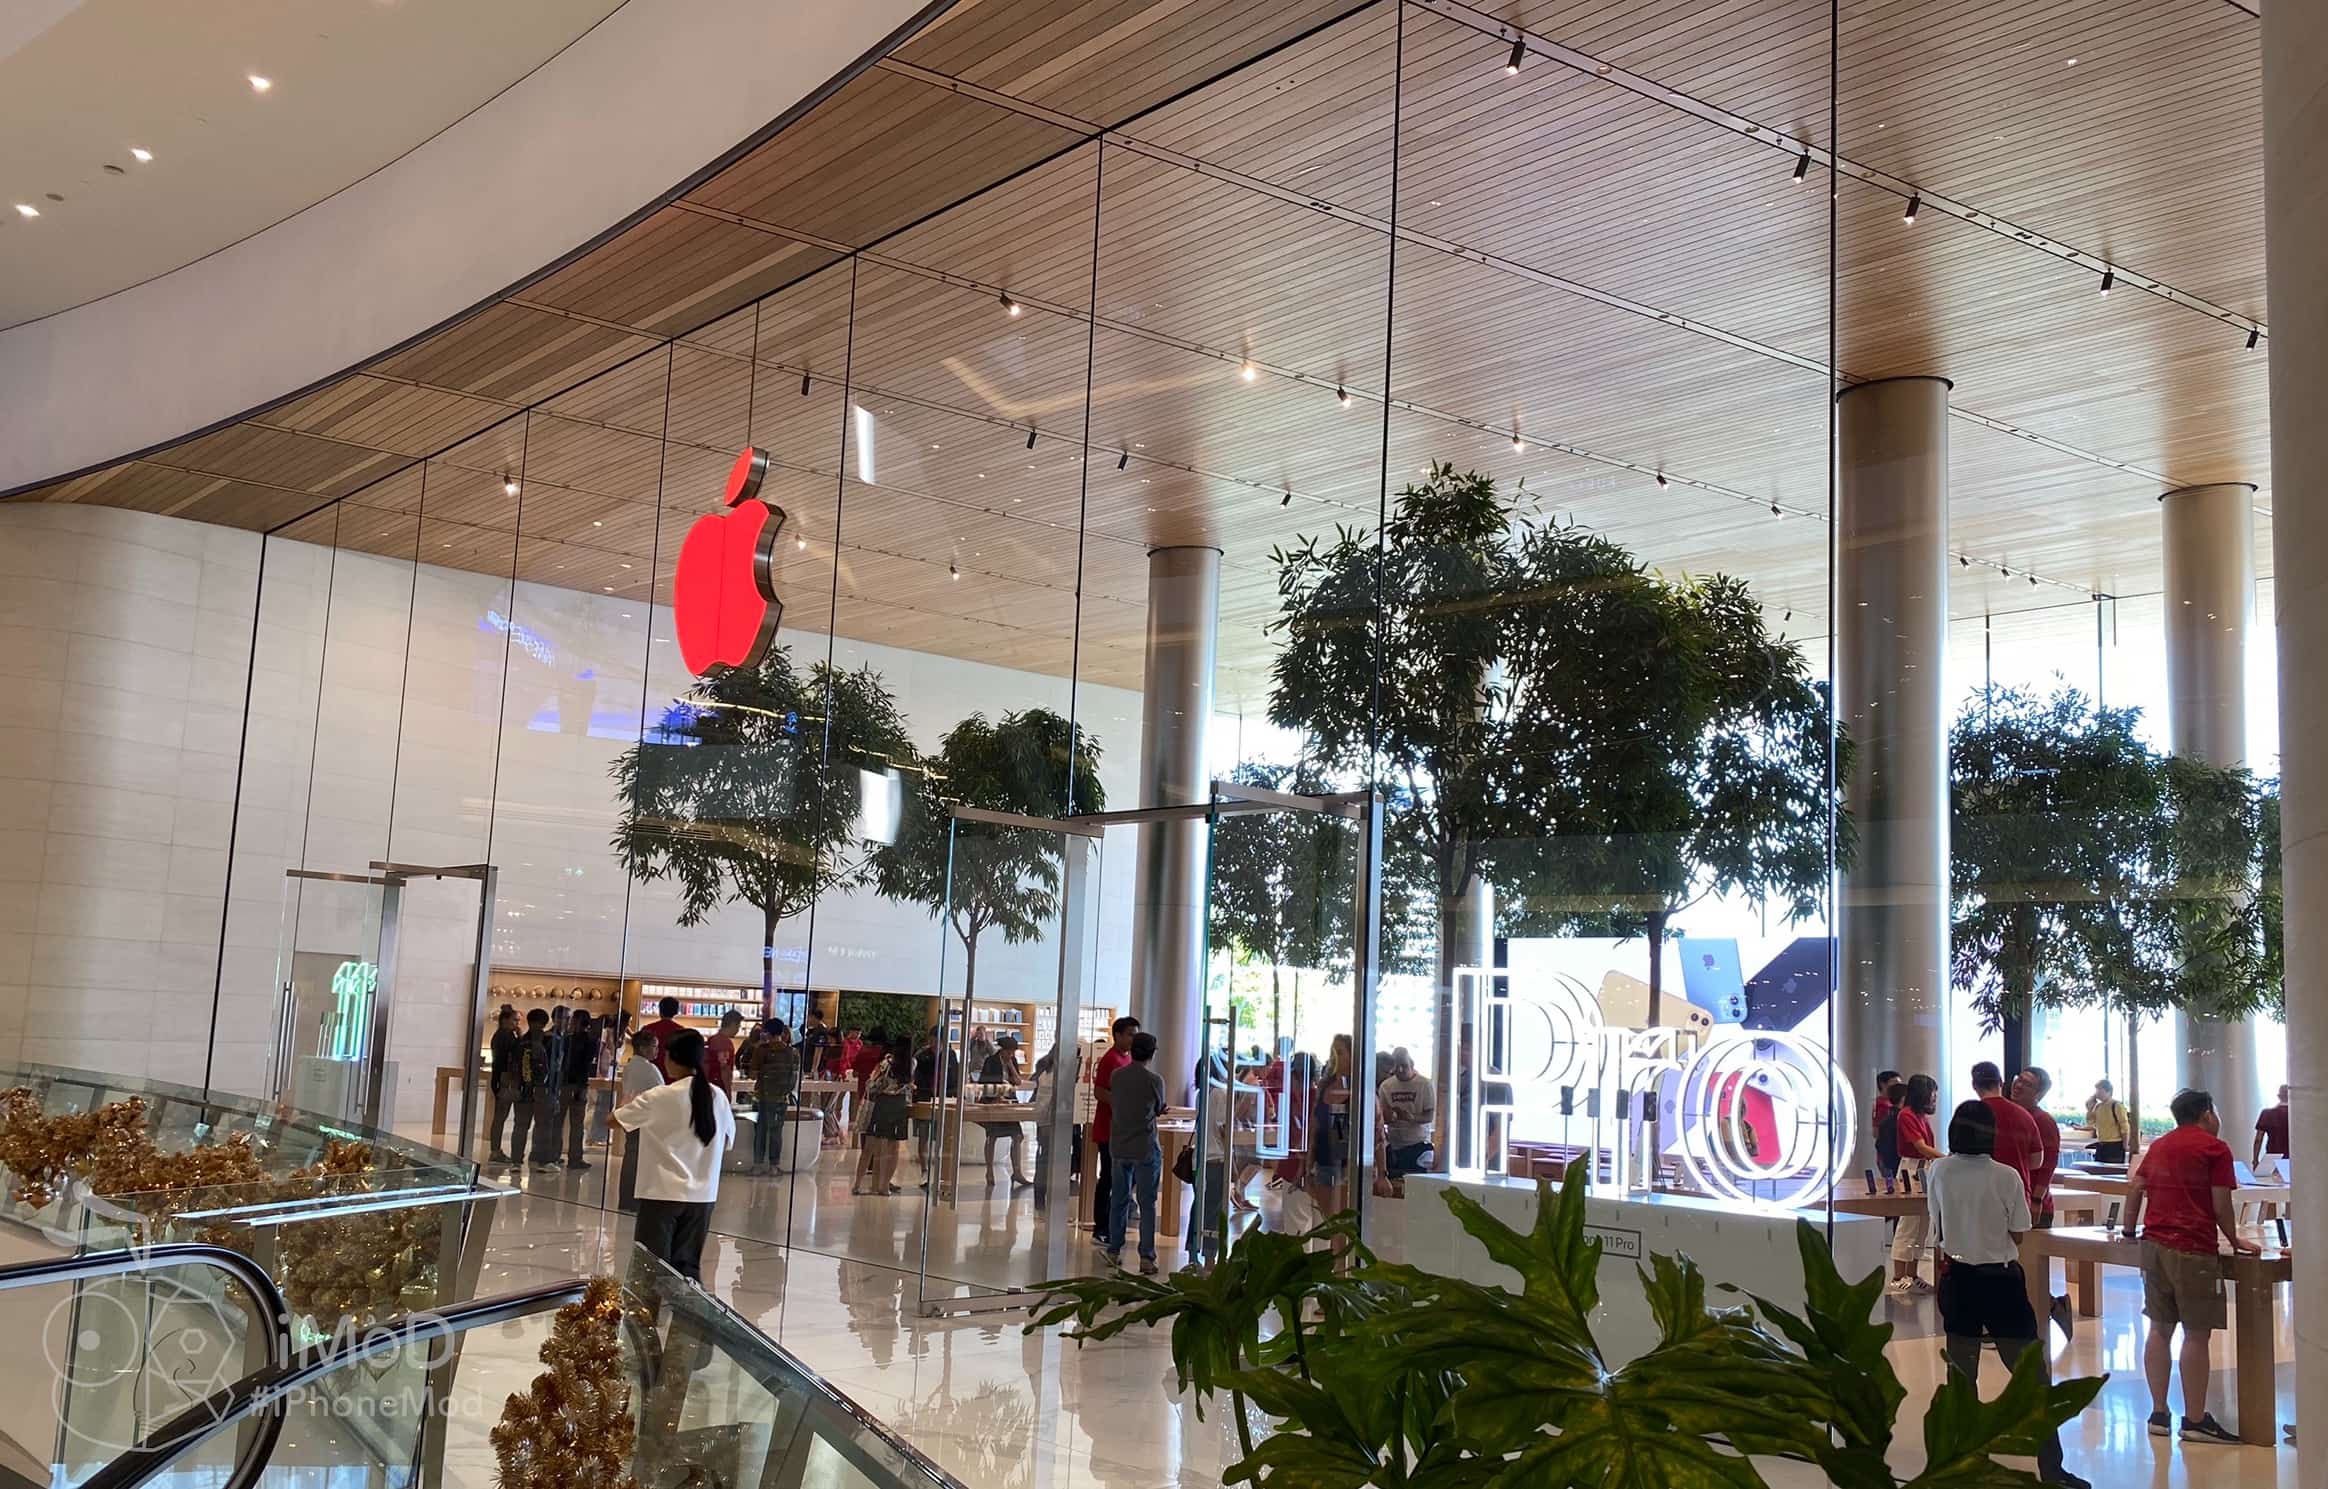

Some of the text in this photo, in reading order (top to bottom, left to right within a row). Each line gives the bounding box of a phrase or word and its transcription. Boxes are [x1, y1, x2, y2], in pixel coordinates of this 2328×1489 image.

[1450, 967, 1857, 1214] Pro
[1604, 1236, 1614, 1248] 11
[1615, 1237, 1635, 1250] Pro
